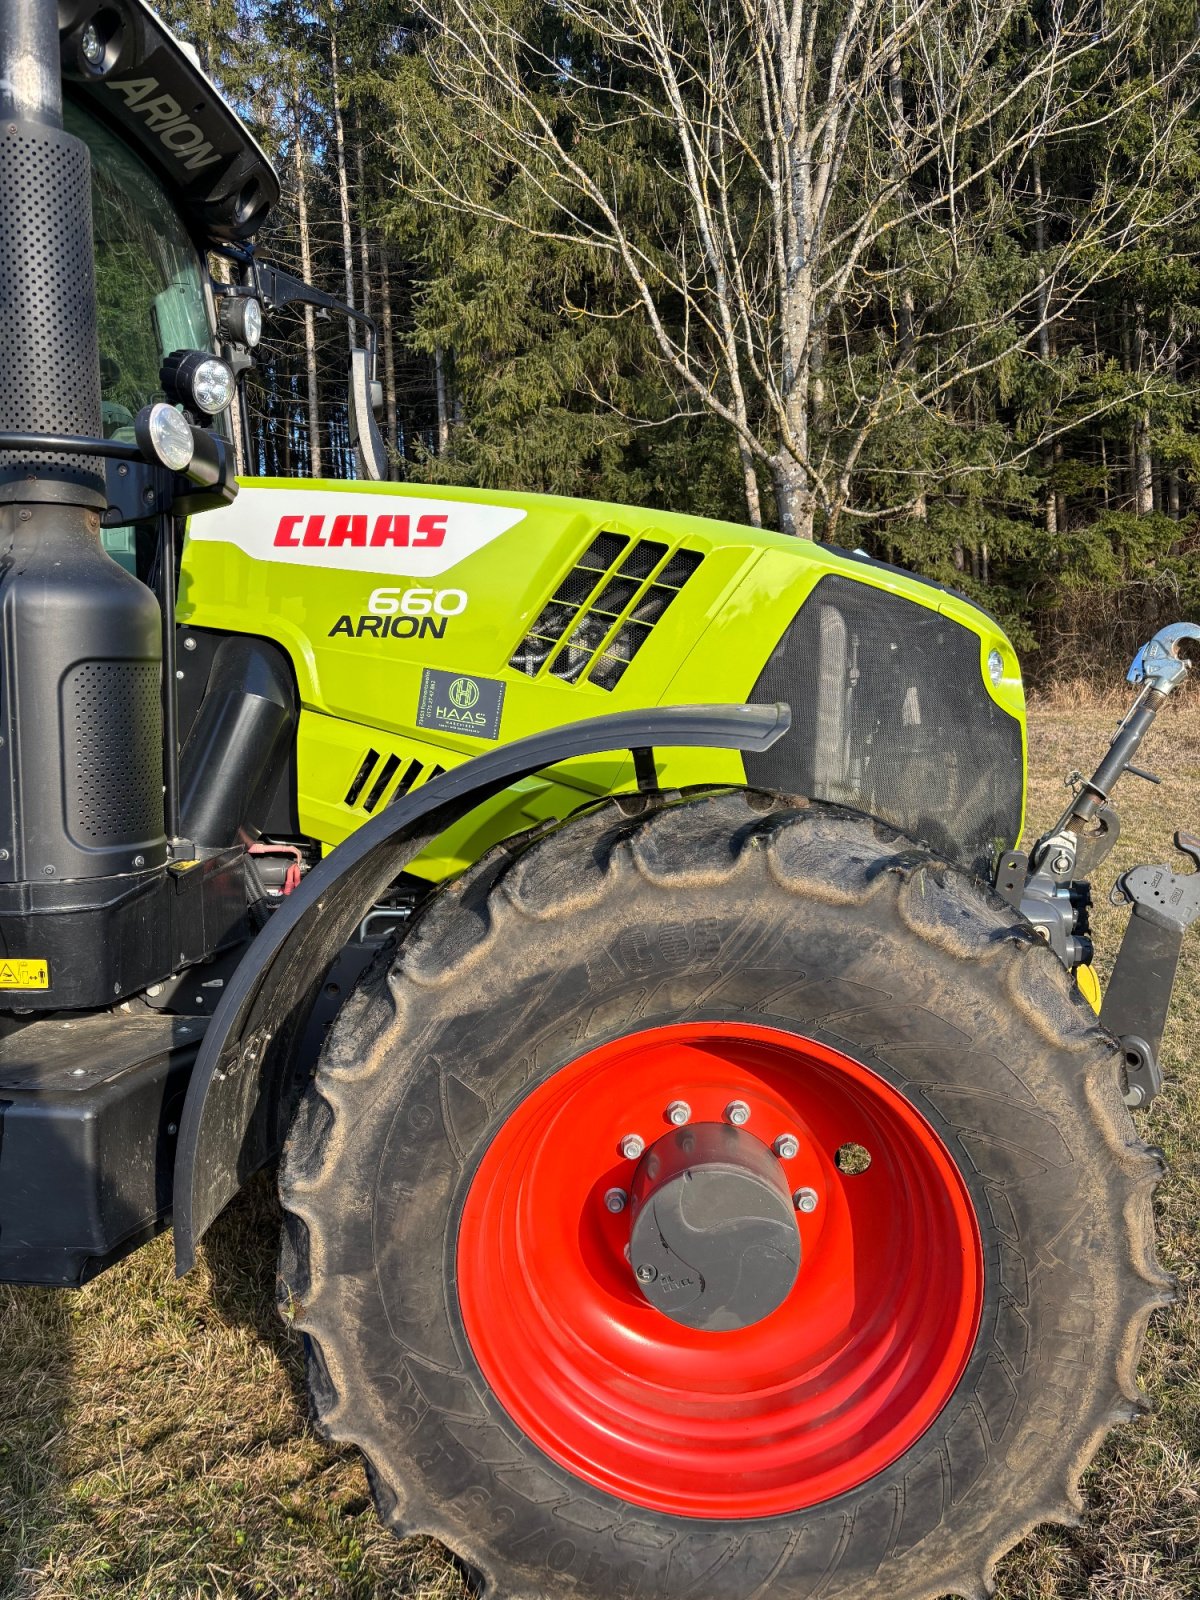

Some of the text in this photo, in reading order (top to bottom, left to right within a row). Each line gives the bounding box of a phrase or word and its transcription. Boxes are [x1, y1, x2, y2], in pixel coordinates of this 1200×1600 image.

[105, 77, 222, 170] ARION
[274, 514, 449, 548] CLAAS
[369, 588, 468, 615] 660
[328, 615, 448, 638] ARION
[436, 706, 487, 724] HAAS
